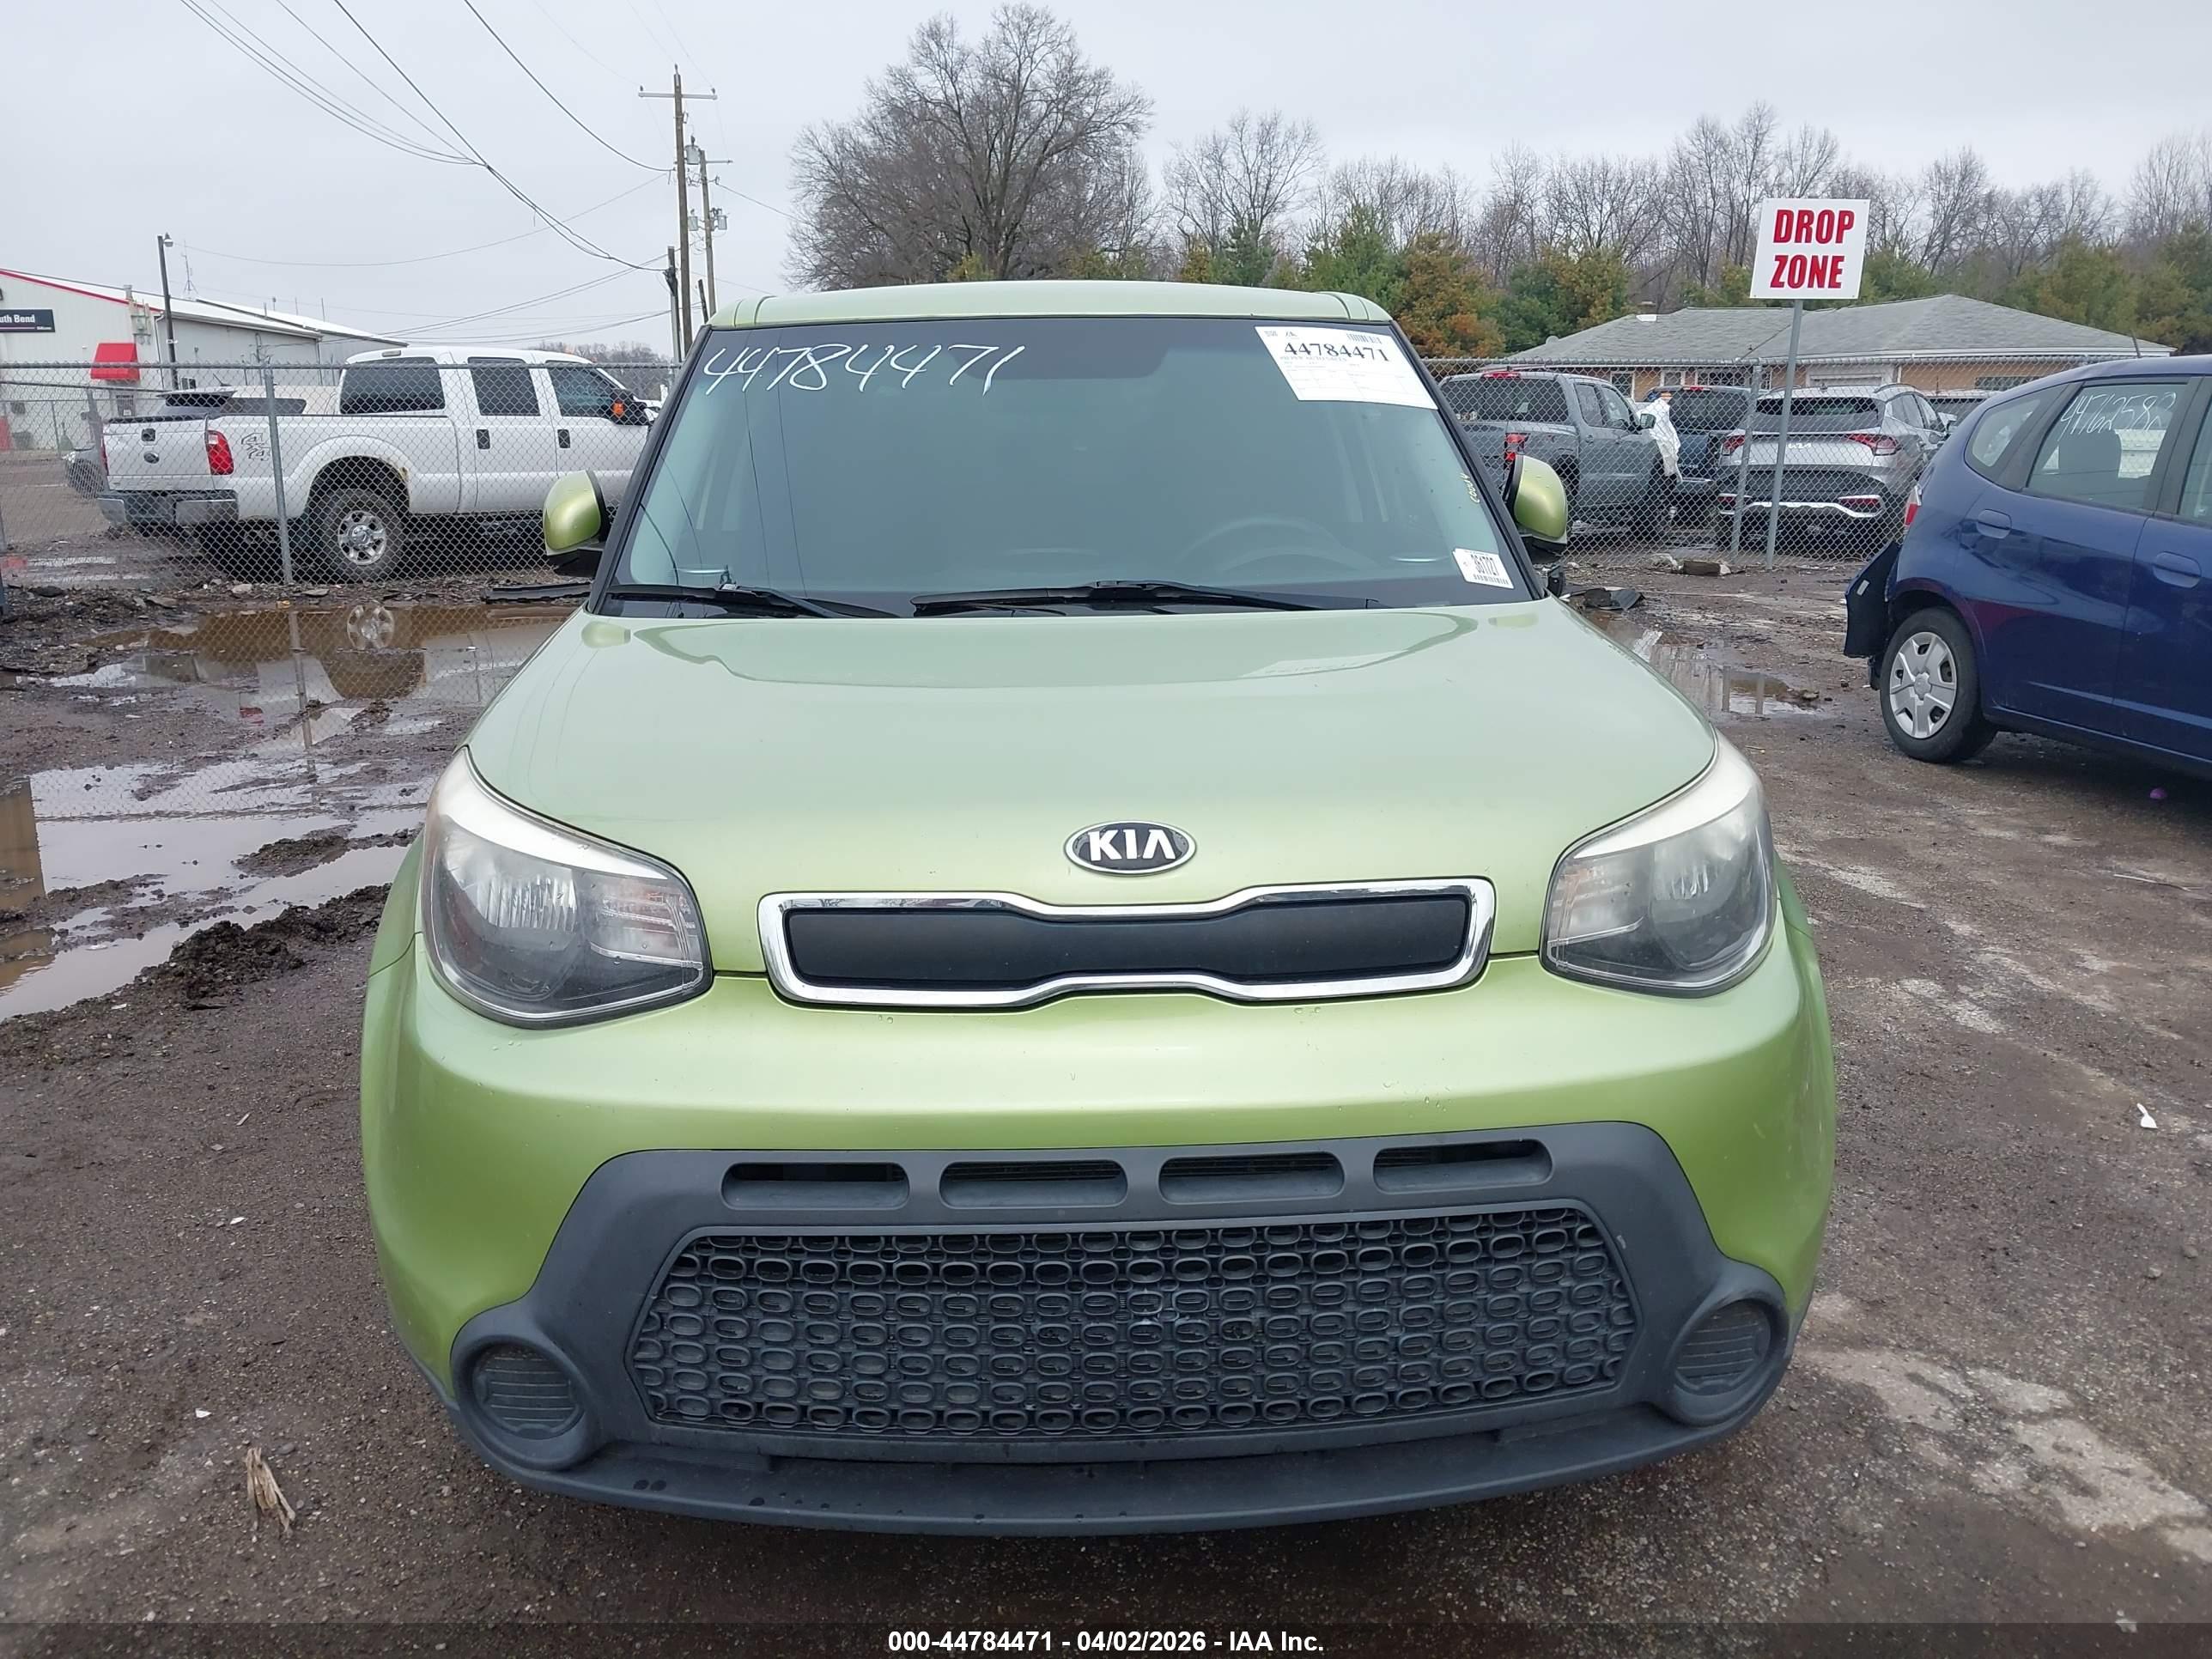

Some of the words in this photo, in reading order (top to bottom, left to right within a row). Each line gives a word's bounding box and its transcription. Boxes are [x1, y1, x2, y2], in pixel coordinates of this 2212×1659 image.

[1772, 209, 1855, 244] DROP
[1770, 254, 1845, 289] ZONE
[14, 314, 35, 323] Bend
[1284, 343, 1389, 362] 44784471
[703, 343, 1026, 397] 44784471
[1087, 829, 1176, 861] KIA
